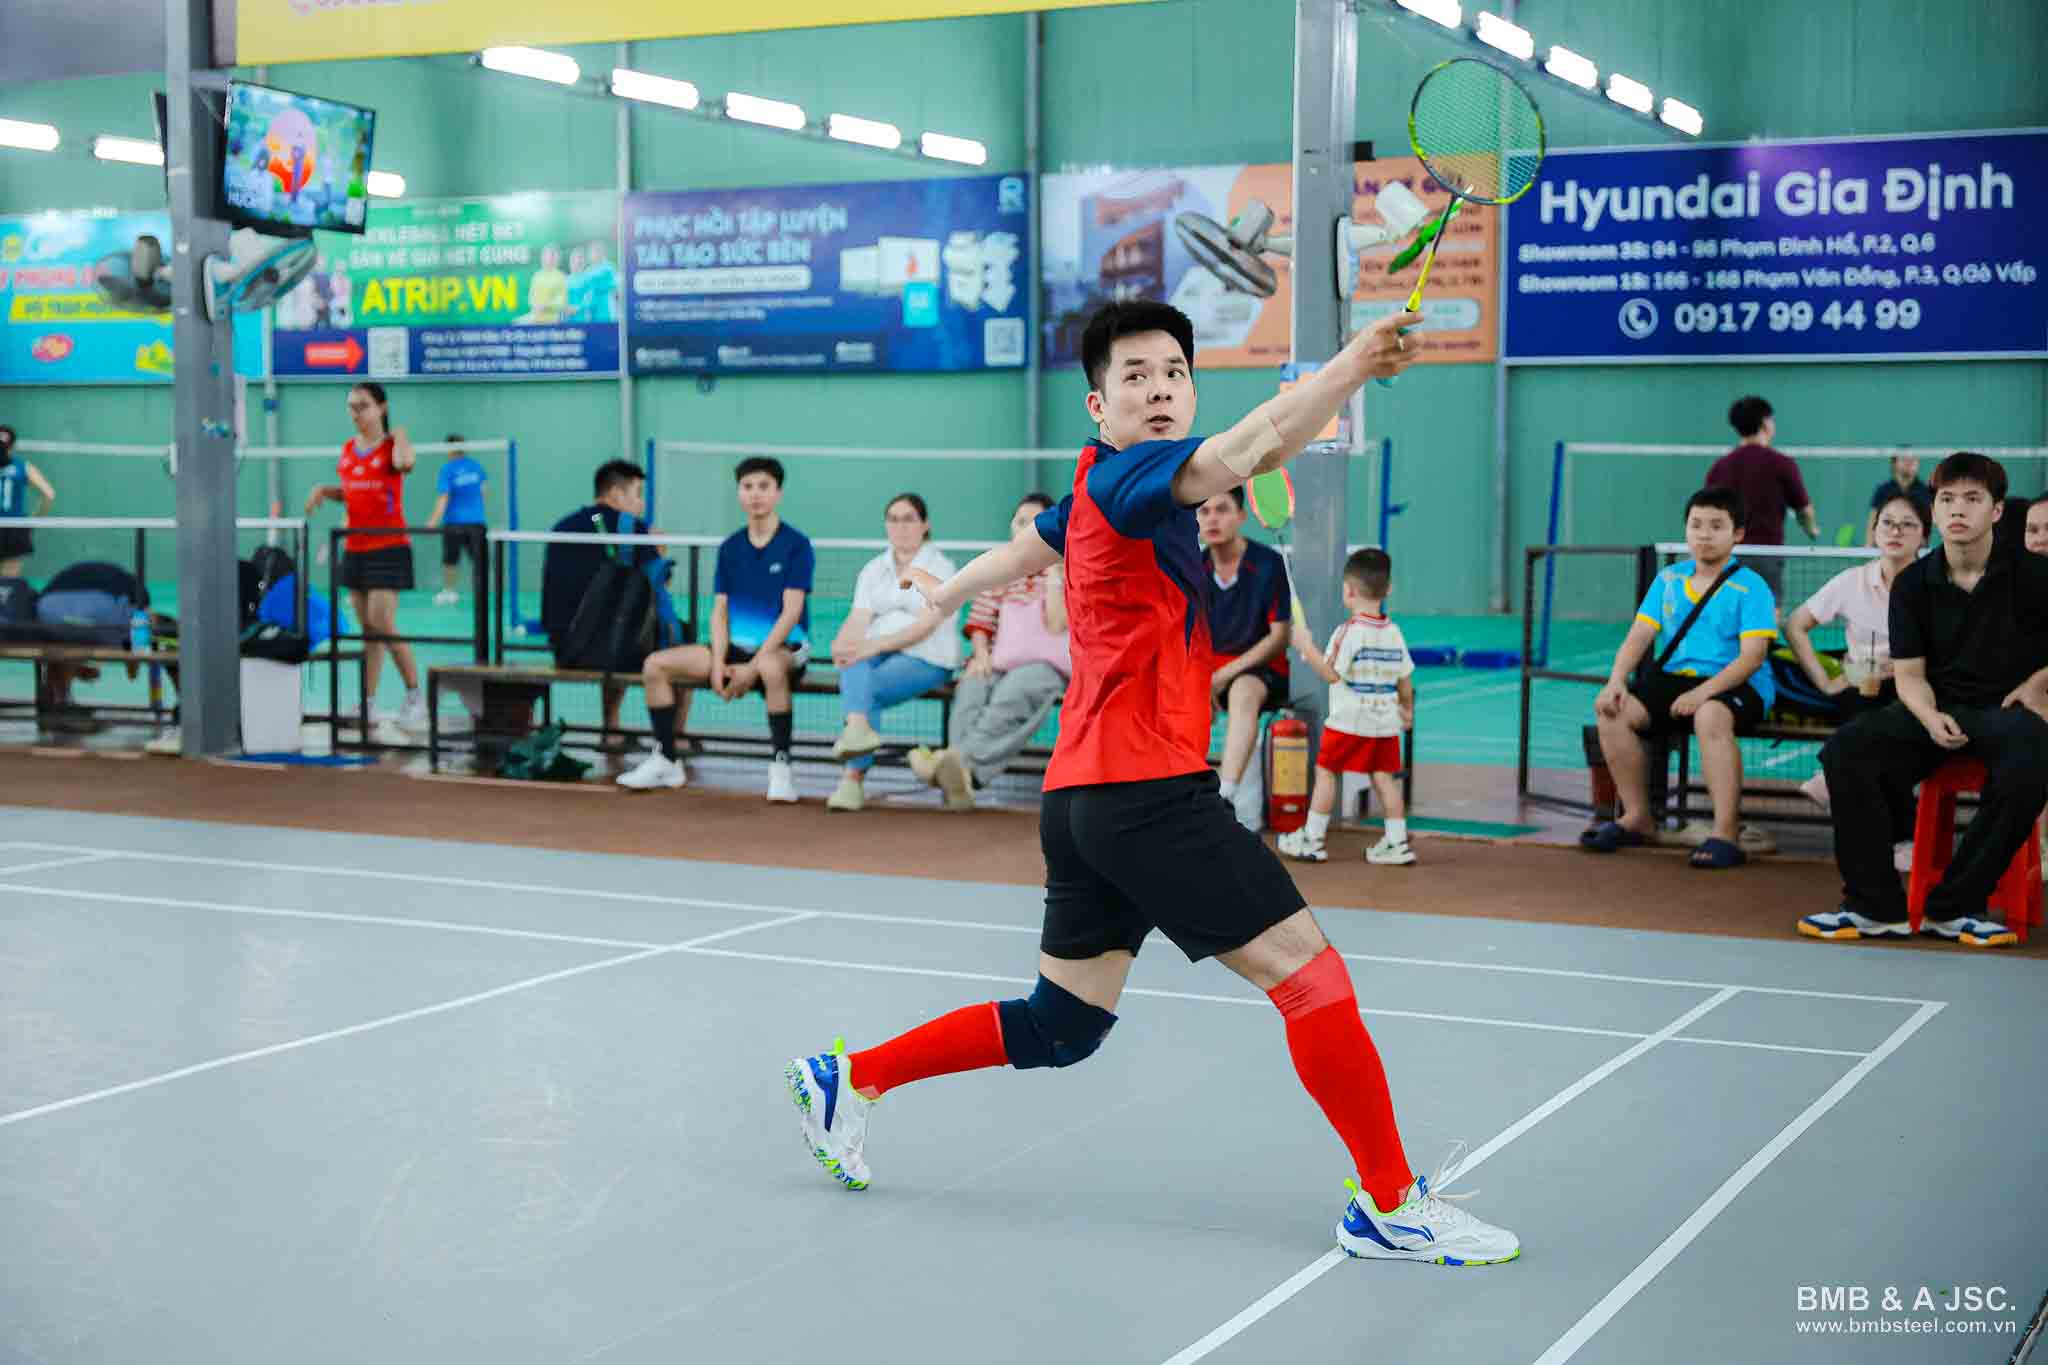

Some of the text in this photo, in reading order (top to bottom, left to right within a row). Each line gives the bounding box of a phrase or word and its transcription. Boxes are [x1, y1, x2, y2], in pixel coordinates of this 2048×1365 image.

[1540, 162, 2014, 232] Hyundai Gia Định
[1518, 243, 1618, 263] Showroom
[1720, 237, 1776, 260] Phạm
[1518, 273, 1618, 293] Showroom
[1743, 269, 1799, 291] Phạm
[1995, 260, 2037, 285] Vấp
[361, 273, 519, 315] ATRIP.VN
[1674, 298, 1921, 332] 0917 99 44 99
